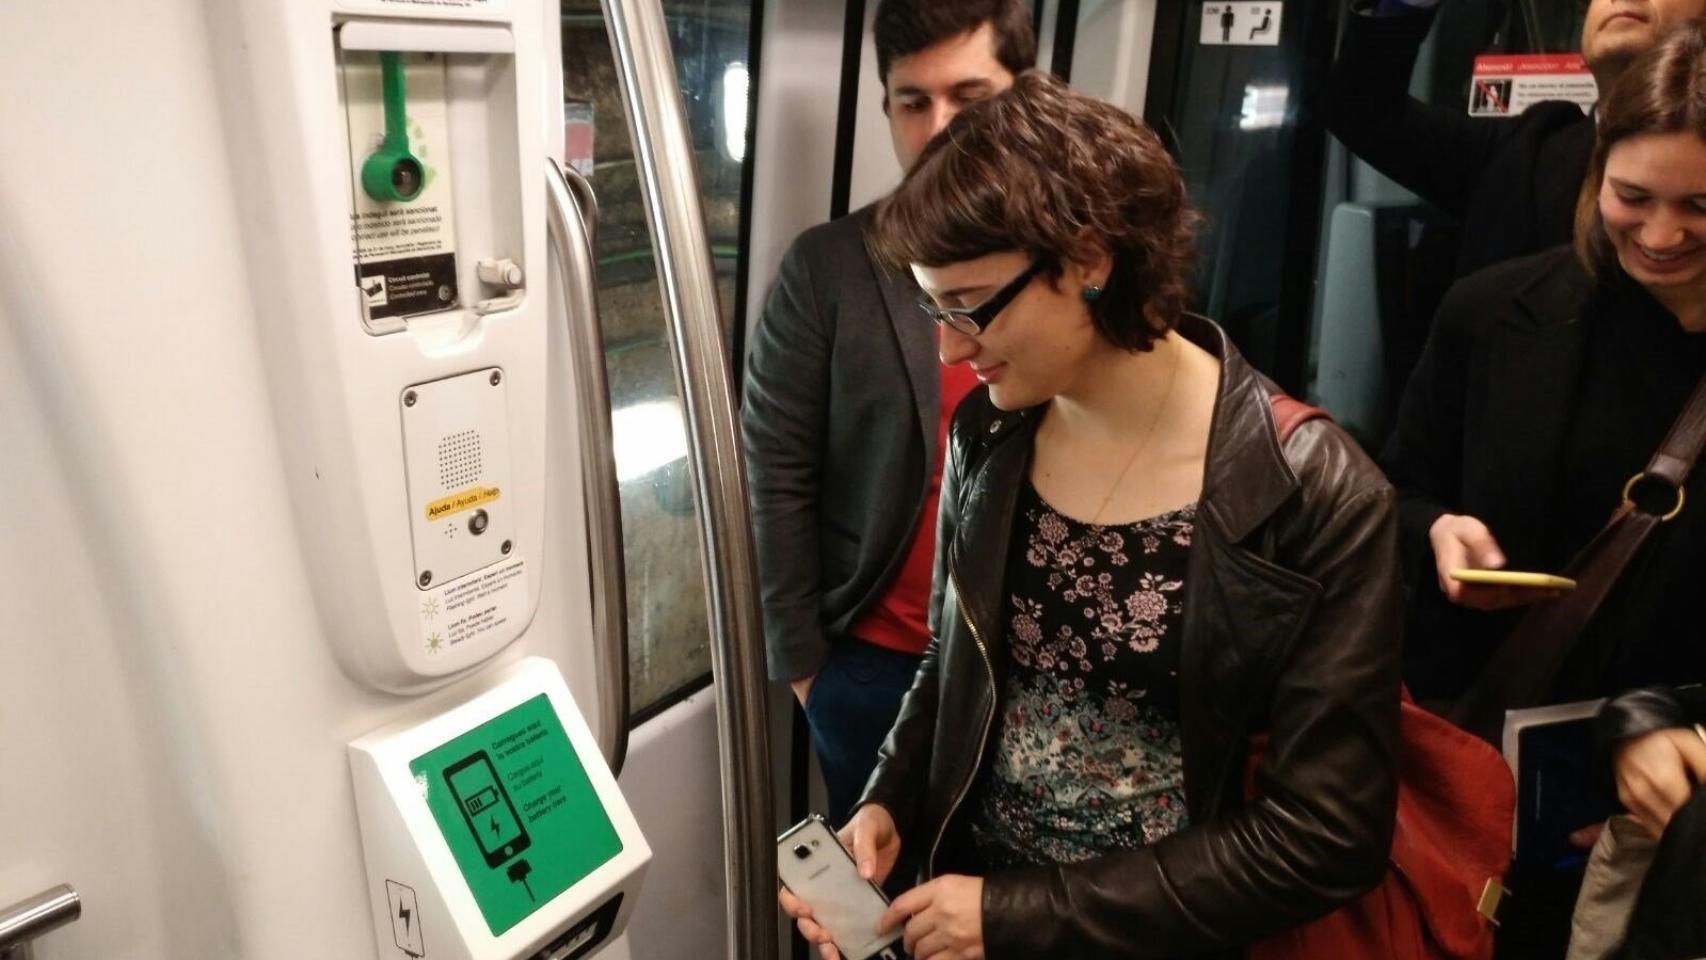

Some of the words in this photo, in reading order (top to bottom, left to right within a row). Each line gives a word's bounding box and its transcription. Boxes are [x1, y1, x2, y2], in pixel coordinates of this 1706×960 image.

[429, 504, 451, 516] Ajuda
[457, 495, 478, 508] Ayuda
[524, 794, 548, 812] Charge
[528, 806, 552, 823] battery
